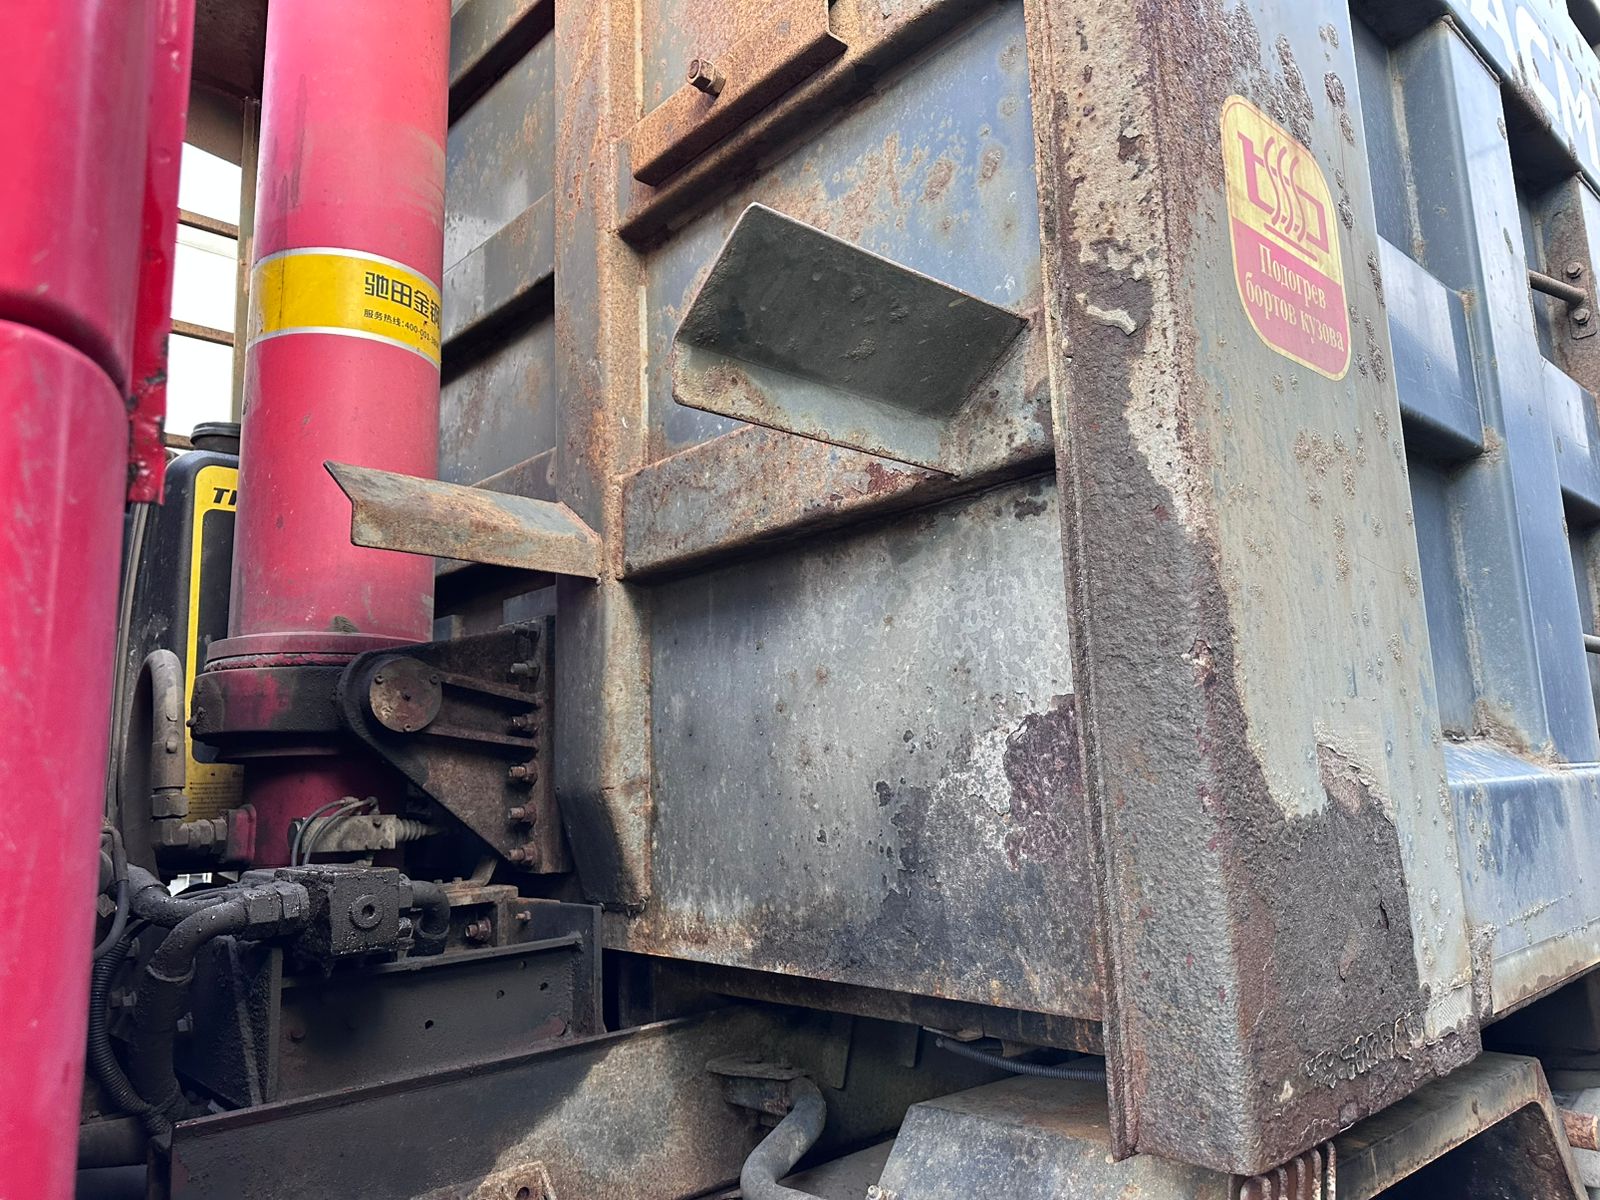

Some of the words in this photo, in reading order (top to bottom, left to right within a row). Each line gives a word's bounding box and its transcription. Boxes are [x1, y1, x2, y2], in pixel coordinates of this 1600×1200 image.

[1245, 272, 1297, 327] бортов
[1300, 309, 1345, 352] кузова
[1258, 243, 1327, 310] Подогрев
